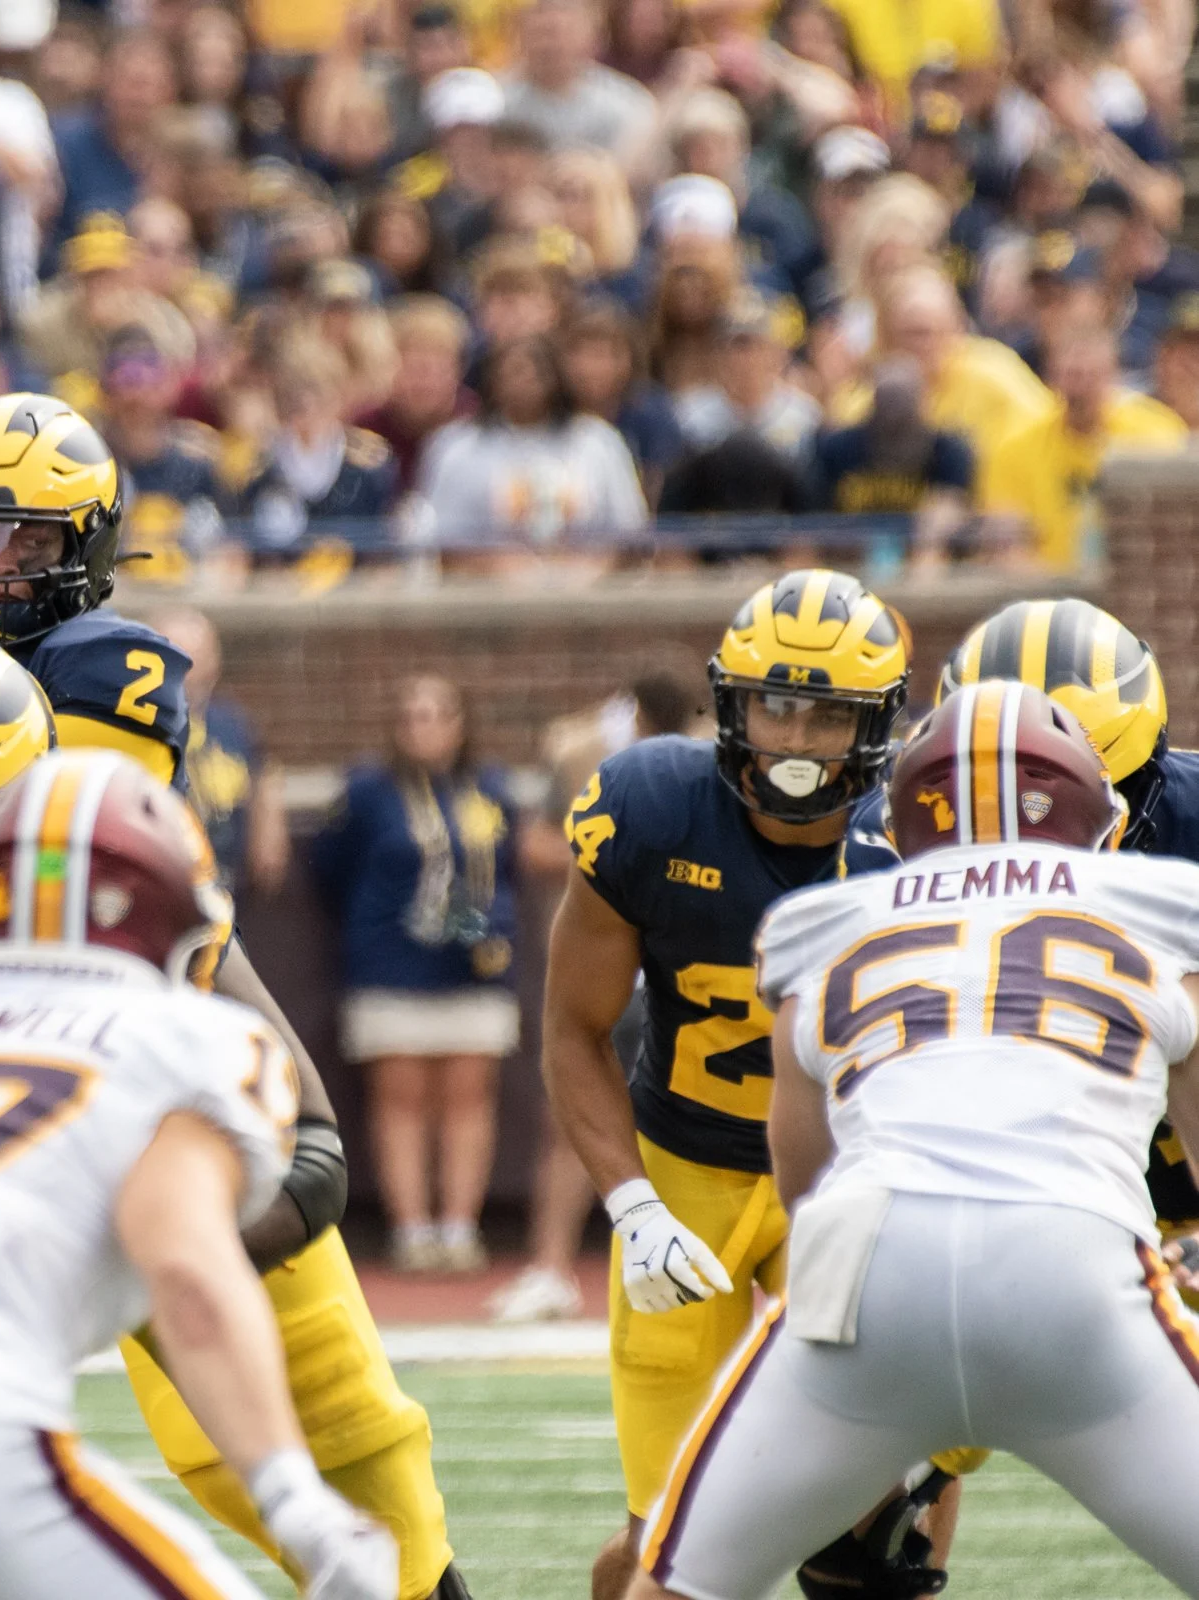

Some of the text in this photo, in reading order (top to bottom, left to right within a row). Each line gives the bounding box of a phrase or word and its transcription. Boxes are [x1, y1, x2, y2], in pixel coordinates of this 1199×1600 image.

[114, 649, 165, 726] 2
[789, 667, 811, 685] M
[892, 859, 1078, 909] DEMMA
[817, 909, 1158, 1103] 56
